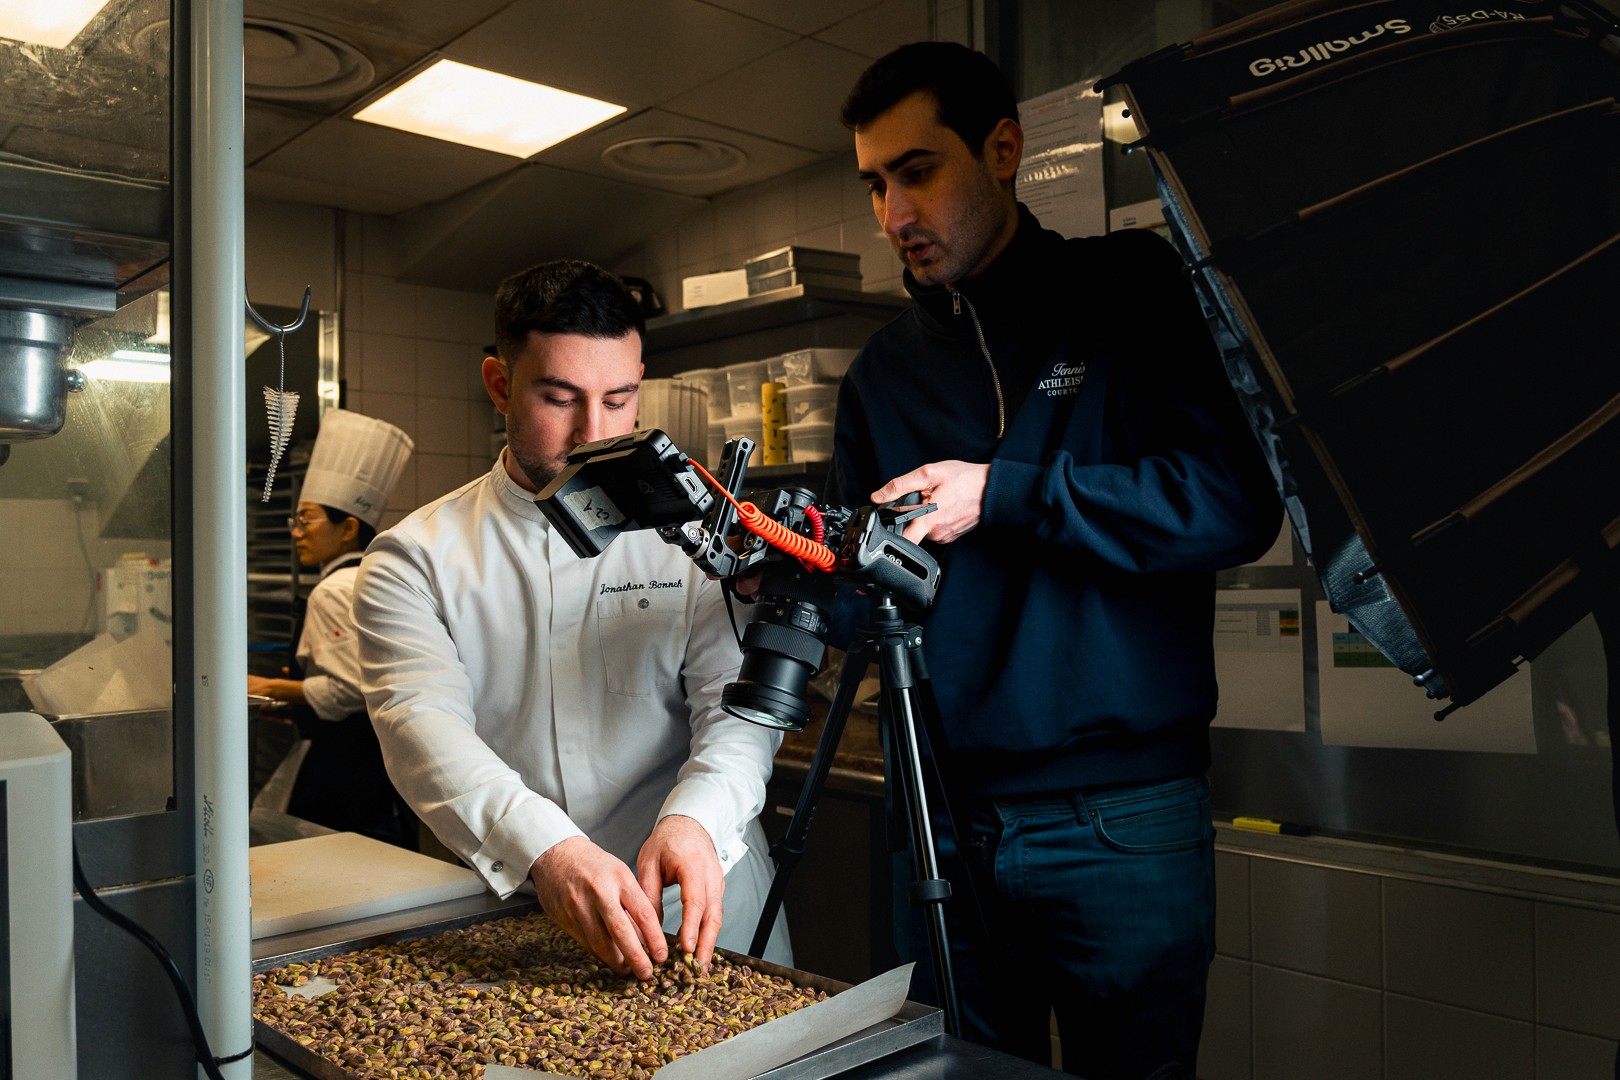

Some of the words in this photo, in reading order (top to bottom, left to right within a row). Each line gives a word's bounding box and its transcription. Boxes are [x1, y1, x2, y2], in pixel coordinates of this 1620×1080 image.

[1442, 9, 1525, 25] RA-D55
[1249, 18, 1411, 77] SmallRig
[1051, 362, 1086, 377] Tennis
[600, 581, 645, 595] Jonathan
